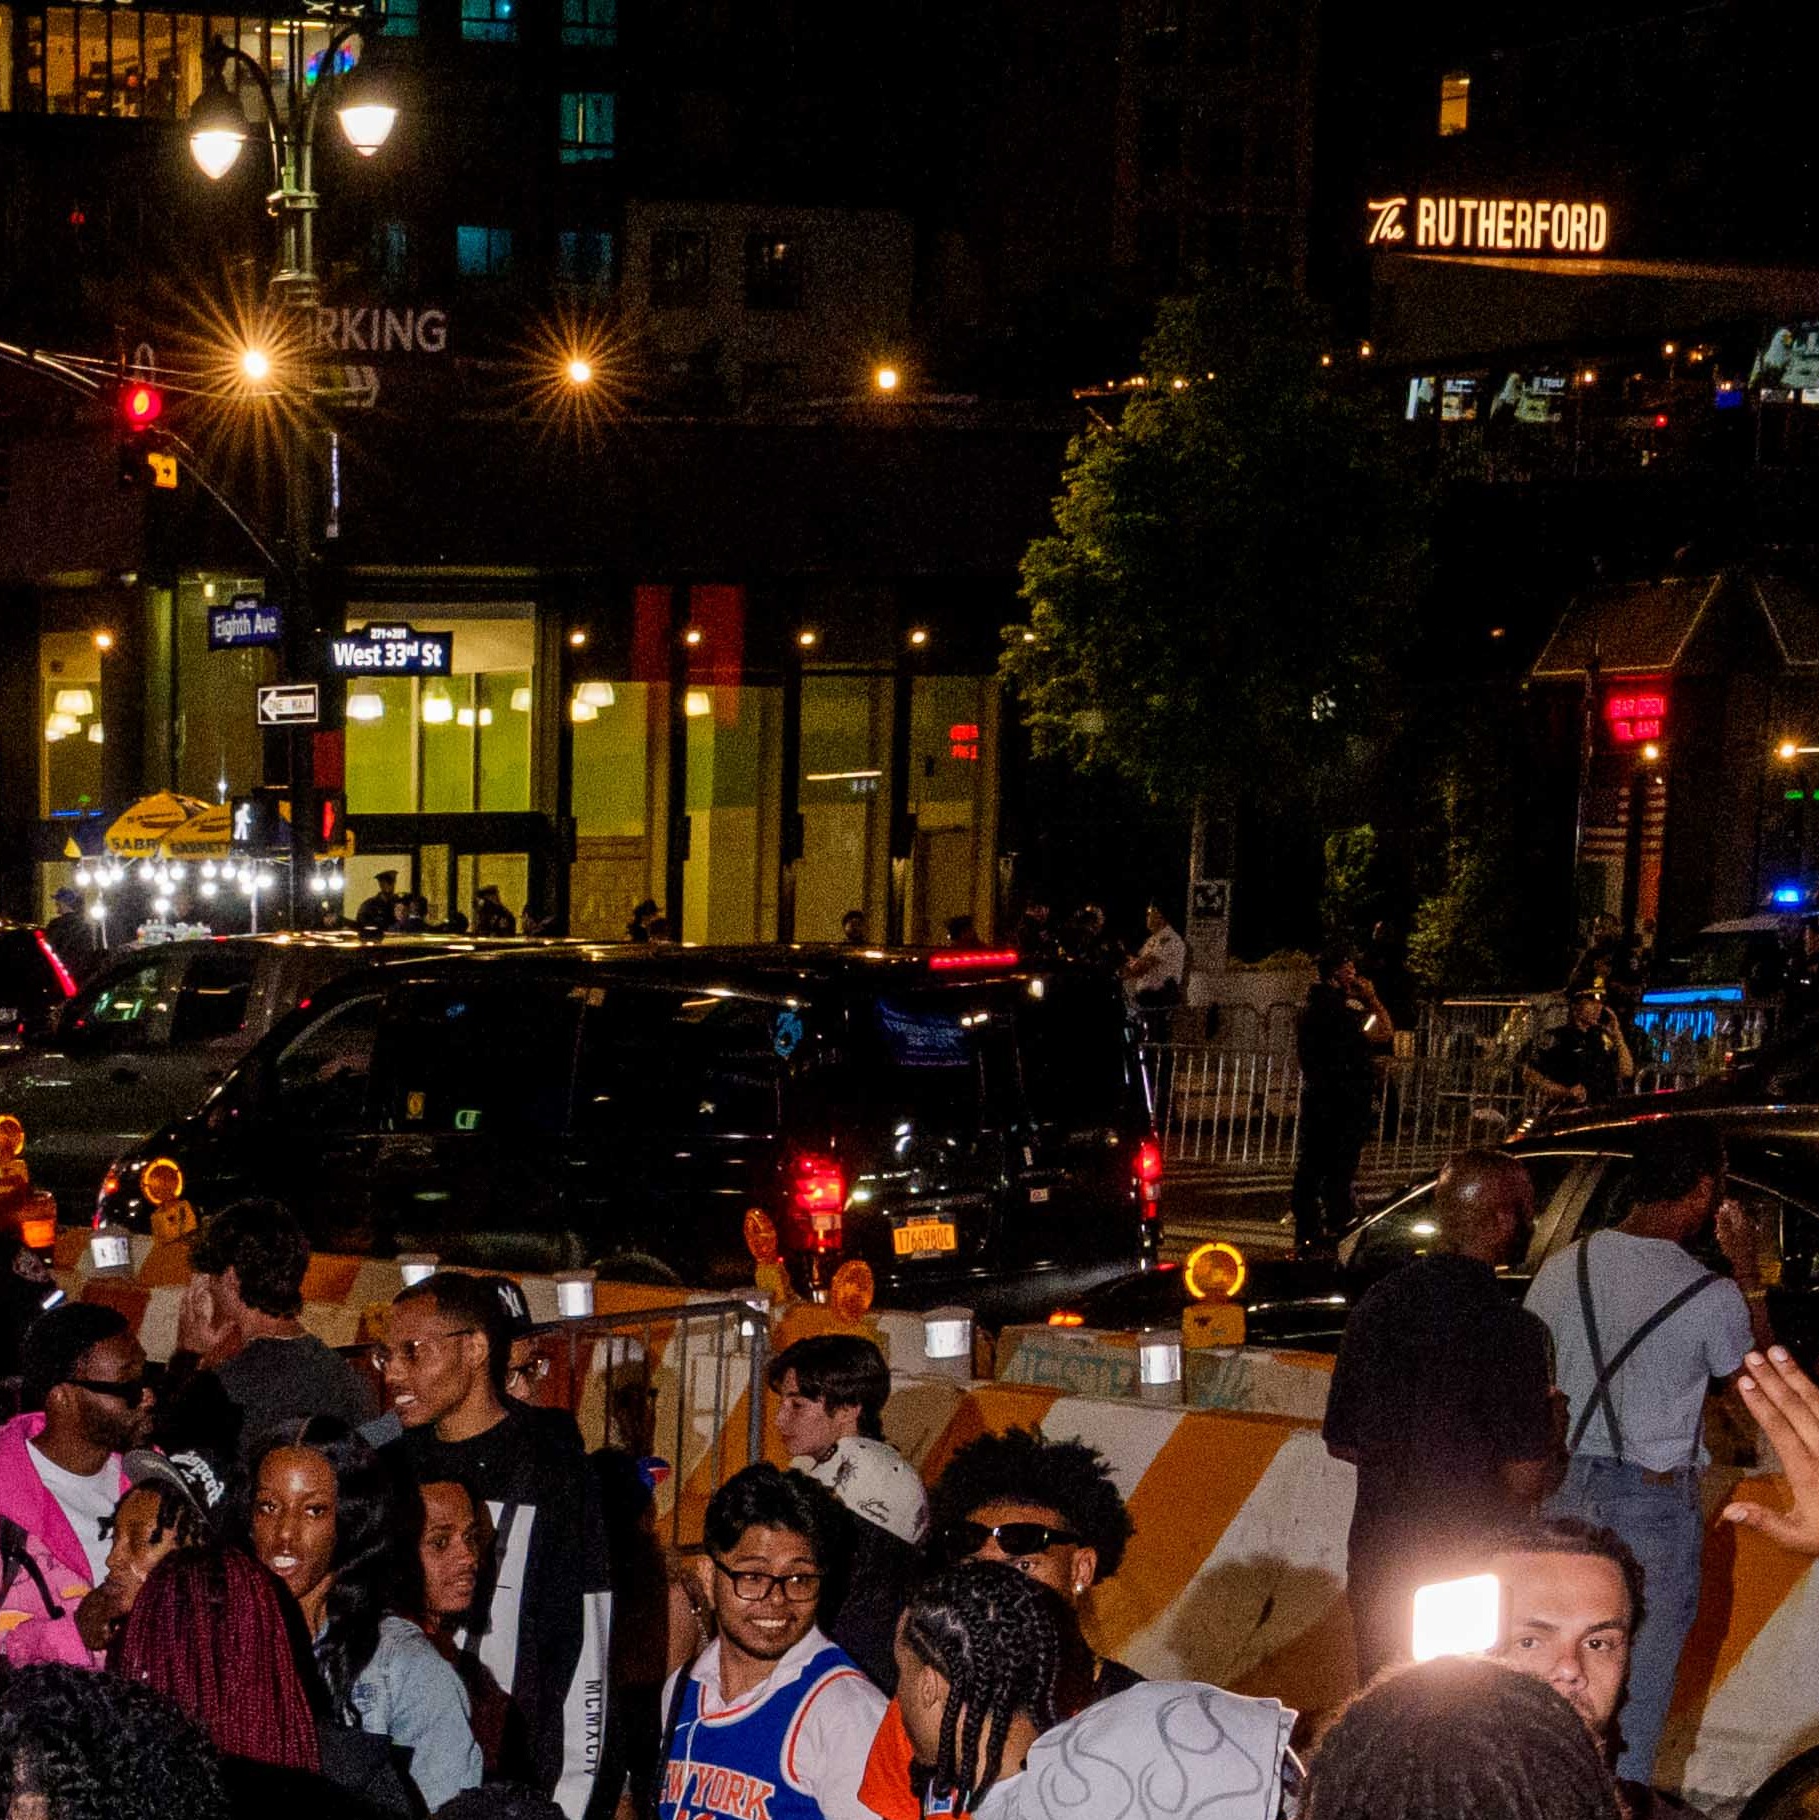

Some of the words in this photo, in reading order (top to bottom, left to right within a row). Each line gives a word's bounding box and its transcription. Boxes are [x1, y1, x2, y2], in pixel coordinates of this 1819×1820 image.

[1368, 197, 1408, 244] The
[1417, 197, 1607, 251] RUTHERFORD
[215, 614, 251, 642] Eighth
[254, 613, 277, 634] Ave
[333, 642, 382, 667] West
[384, 642, 419, 667] 33rd
[421, 642, 442, 667] St
